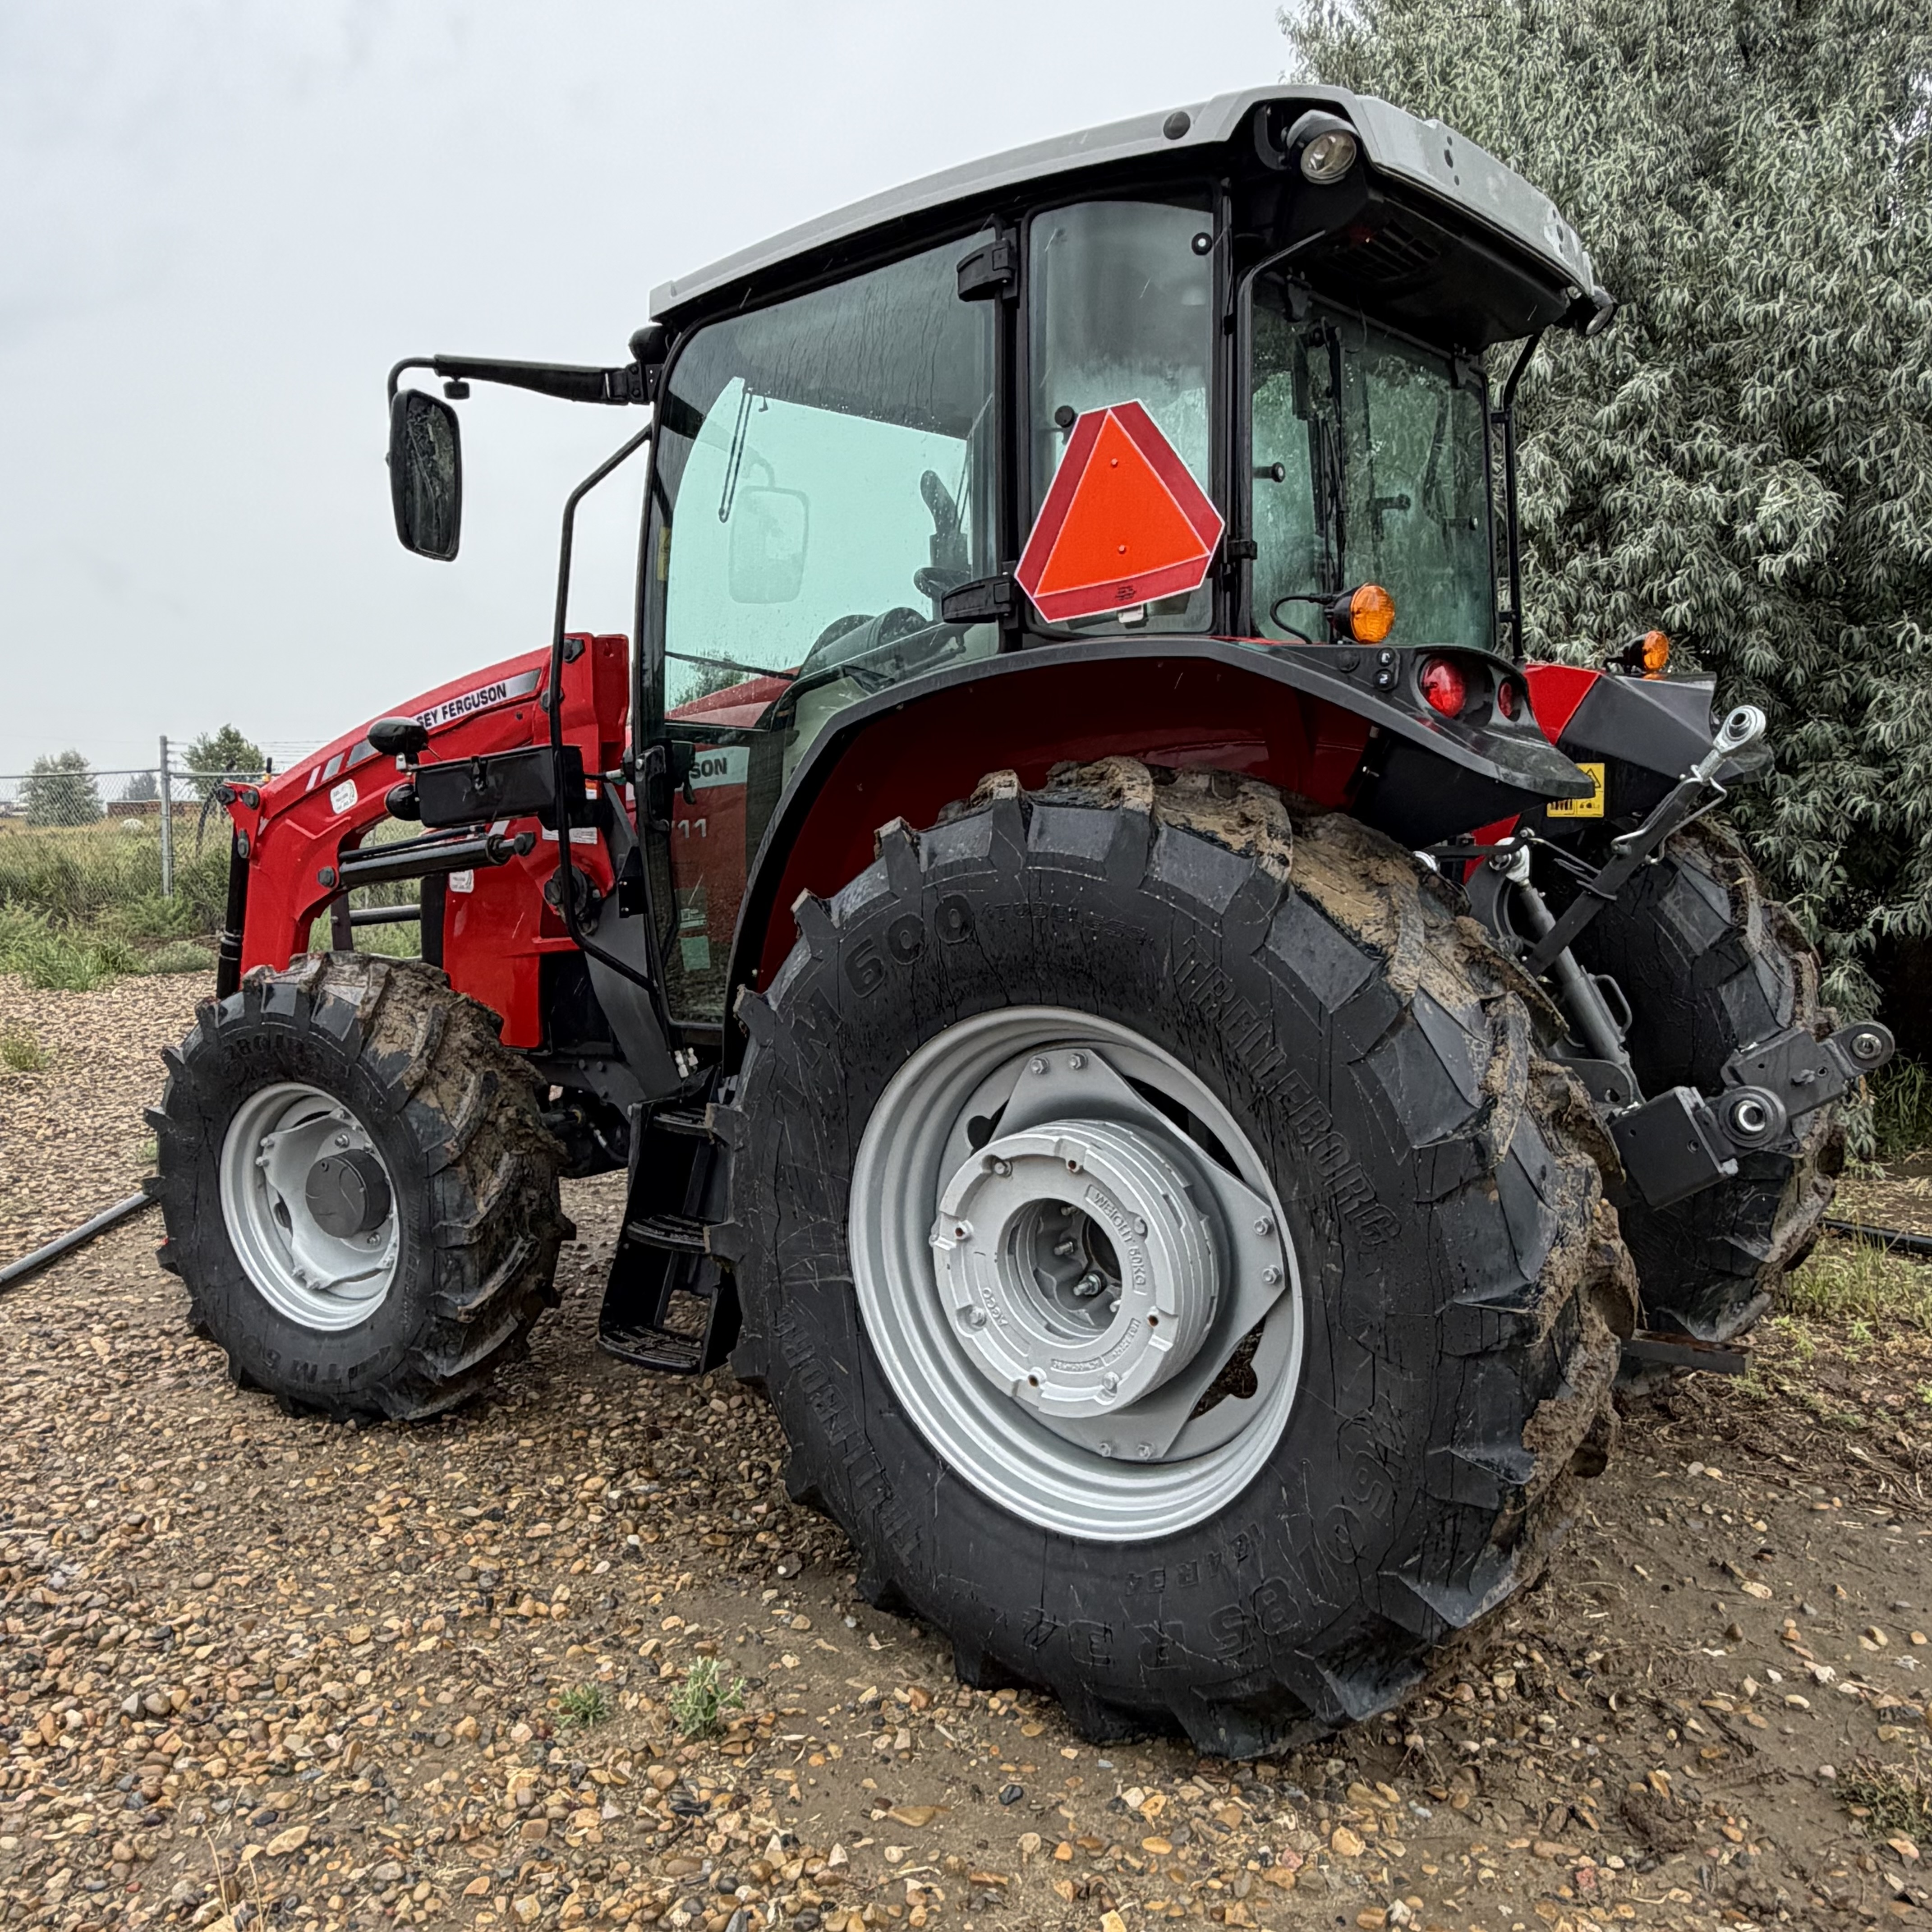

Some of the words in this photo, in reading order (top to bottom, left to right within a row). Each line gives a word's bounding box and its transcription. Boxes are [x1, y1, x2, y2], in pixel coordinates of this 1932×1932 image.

[442, 683, 506, 720] FERGUSON
[843, 892, 975, 998] 600
[1174, 935, 1402, 1247] TRELLEBORG
[1095, 1191, 1133, 1242] WEIGHT
[983, 1287, 1008, 1325] AGCO
[772, 1304, 923, 1568] TRELLEBORG
